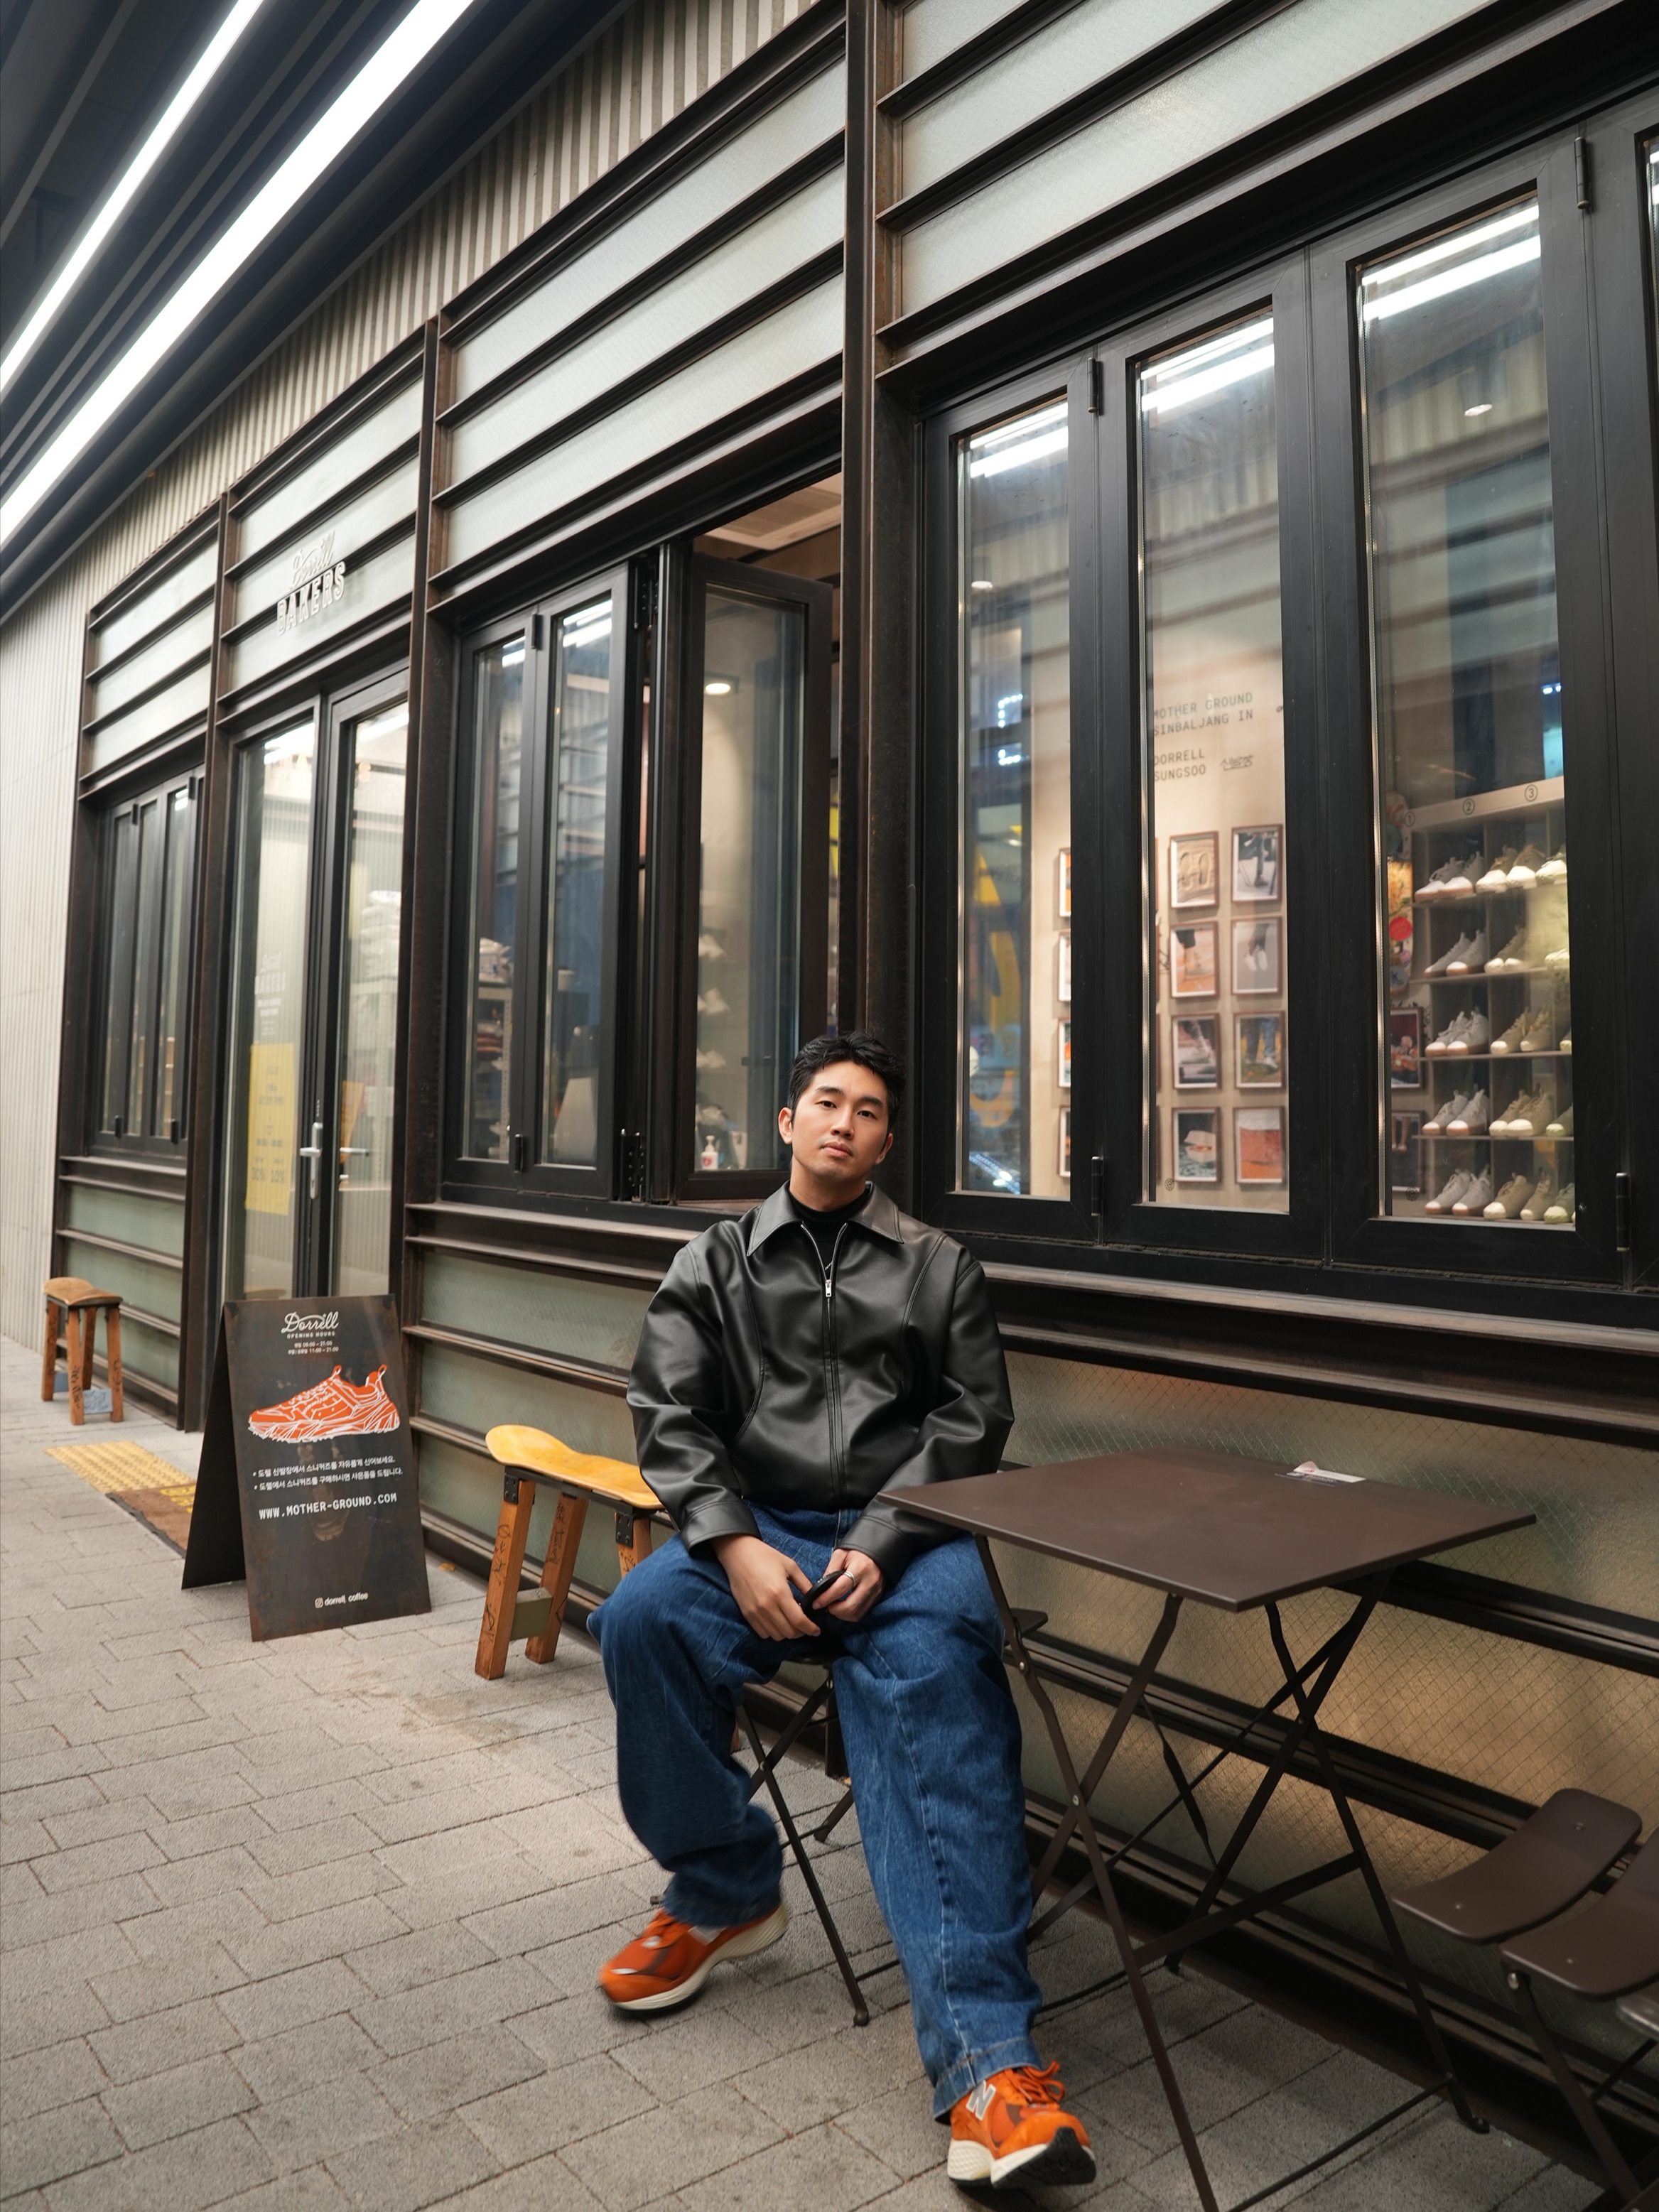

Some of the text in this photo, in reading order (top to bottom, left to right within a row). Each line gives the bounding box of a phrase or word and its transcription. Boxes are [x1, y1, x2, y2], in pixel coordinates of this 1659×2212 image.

[276, 560, 346, 636] BAKERS
[1154, 692, 1253, 720] MOTHER GROUND
[1154, 709, 1253, 737] SINBALJANG IN
[1154, 748, 1206, 766] DORRELL
[1155, 764, 1206, 781] SUNGSOO
[281, 1311, 339, 1334] Dorrell
[272, 1465, 305, 1477] 신발장에서
[966, 2079, 997, 2121] N
